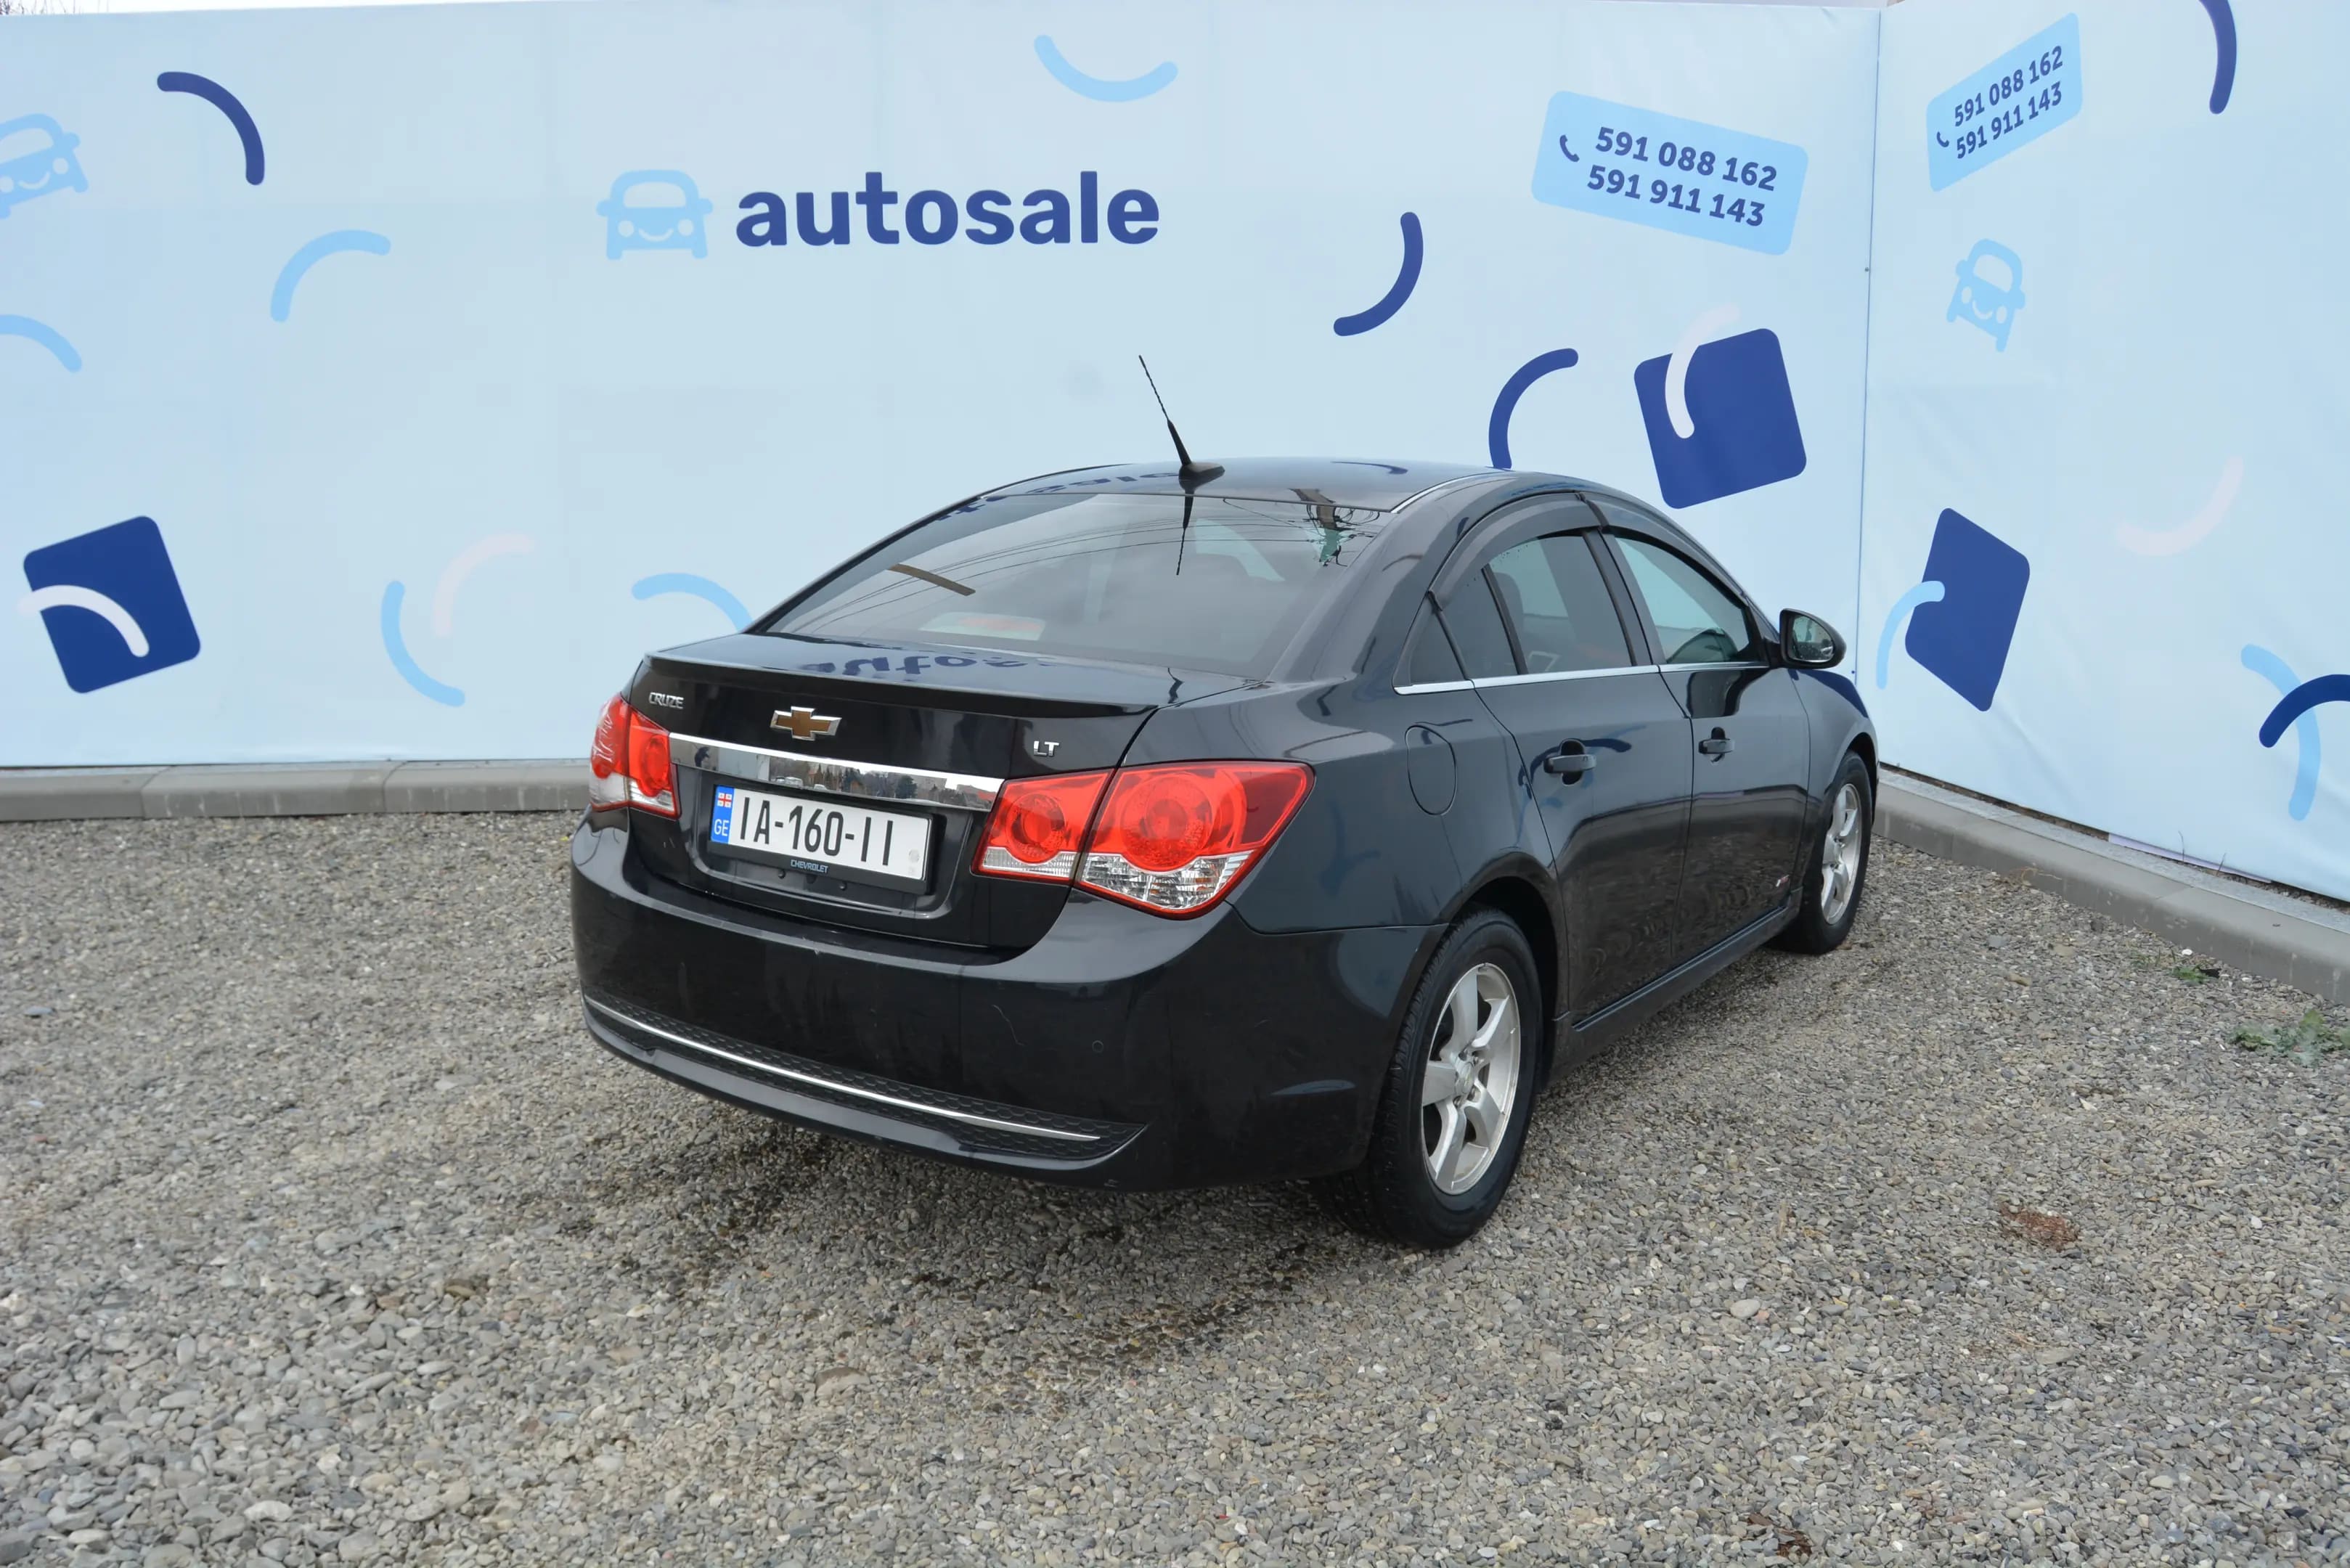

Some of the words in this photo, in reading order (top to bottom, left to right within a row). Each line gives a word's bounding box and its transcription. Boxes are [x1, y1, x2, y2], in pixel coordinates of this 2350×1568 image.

[1954, 92, 1986, 127] 591
[1988, 69, 2024, 107] 088
[2028, 45, 2063, 85] 162
[1957, 125, 1988, 160] 591
[1991, 104, 2024, 141] 911
[2028, 81, 2063, 121] 143
[1595, 126, 1649, 162] 591
[1658, 142, 1716, 176] 088
[1722, 157, 1777, 192] 162
[736, 171, 1159, 248] autosale
[1586, 164, 1641, 200] 591
[1649, 179, 1702, 214] 911
[1709, 193, 1766, 227] 143
[648, 692, 685, 709] CRUZE
[1033, 740, 1060, 756] LT
[714, 818, 730, 837] GE
[790, 859, 829, 874] CHEVROLET
